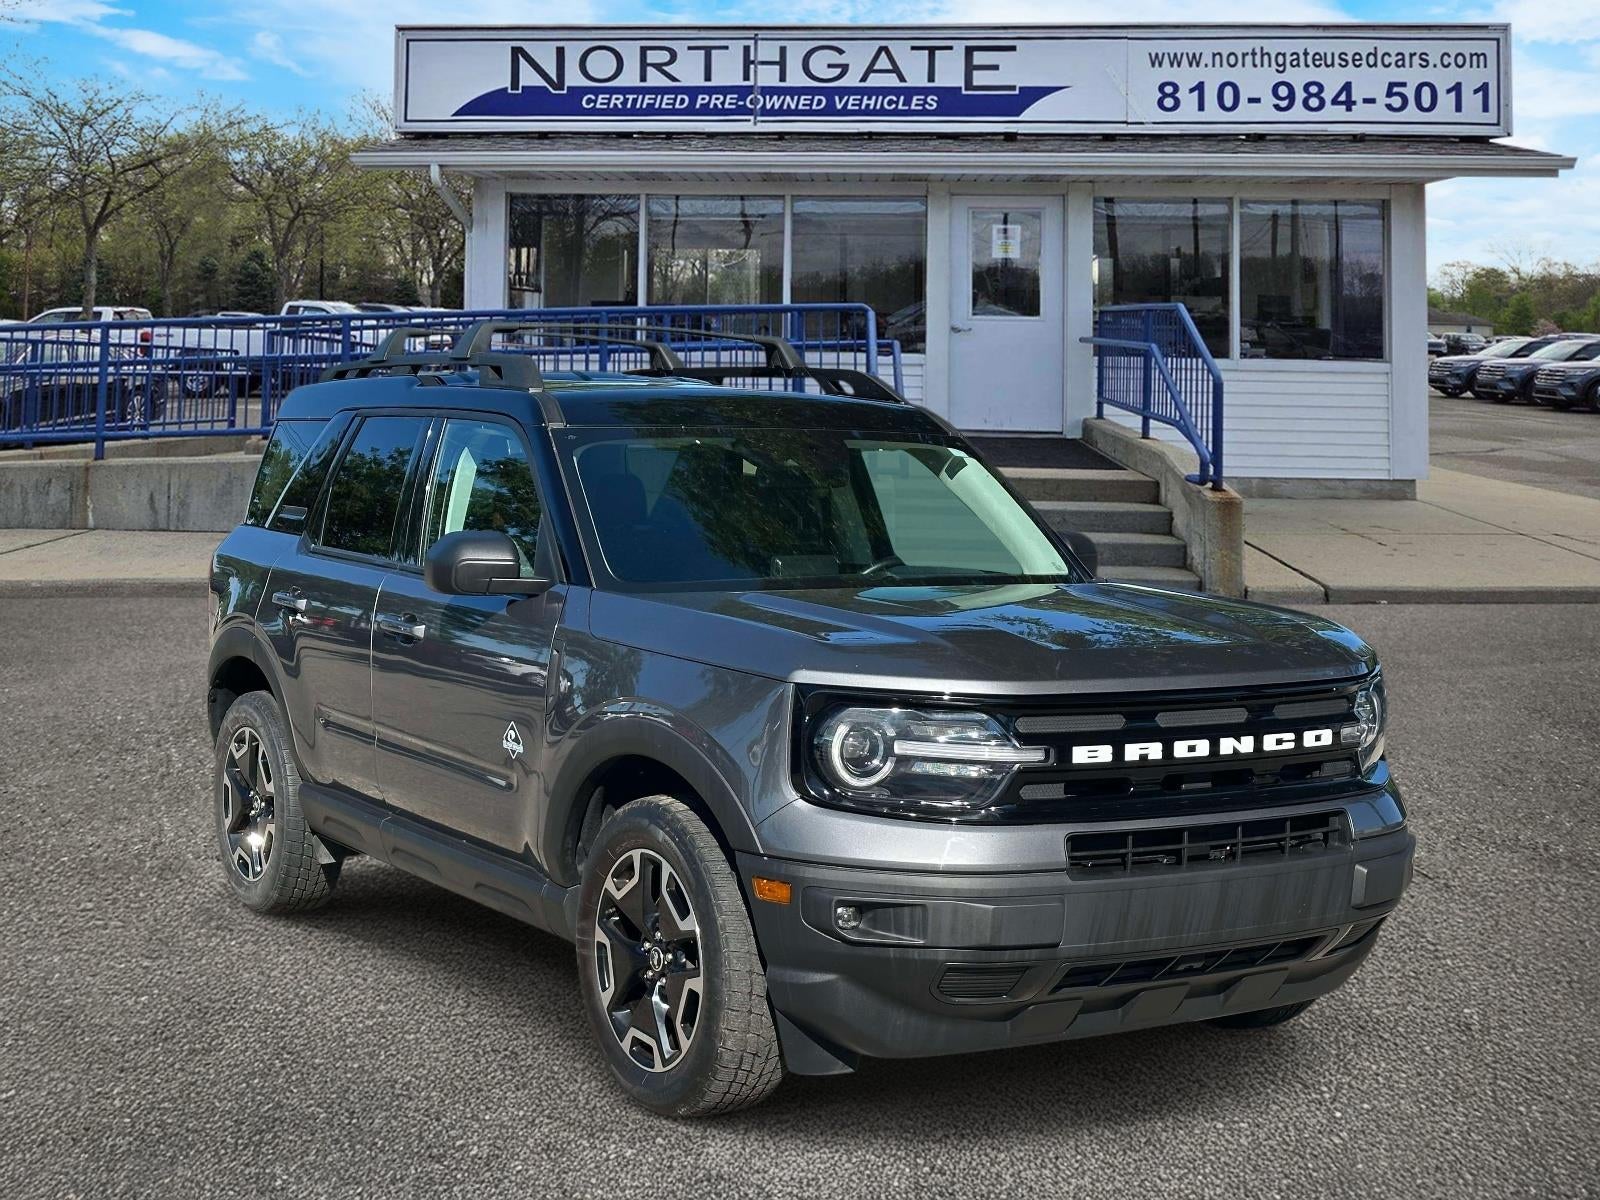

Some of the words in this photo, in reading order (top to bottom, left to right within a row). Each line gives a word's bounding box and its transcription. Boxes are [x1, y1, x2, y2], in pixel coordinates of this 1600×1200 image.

[509, 44, 1018, 92] NORTHGATE
[1148, 46, 1488, 74] www.northgateusedcars.com
[581, 93, 689, 110] CERTIFIED
[695, 94, 827, 111] PRE-OWNED
[834, 95, 938, 111] VEHICLES
[1156, 80, 1491, 113] 810-984-5011
[1072, 728, 1333, 764] BRONCO
